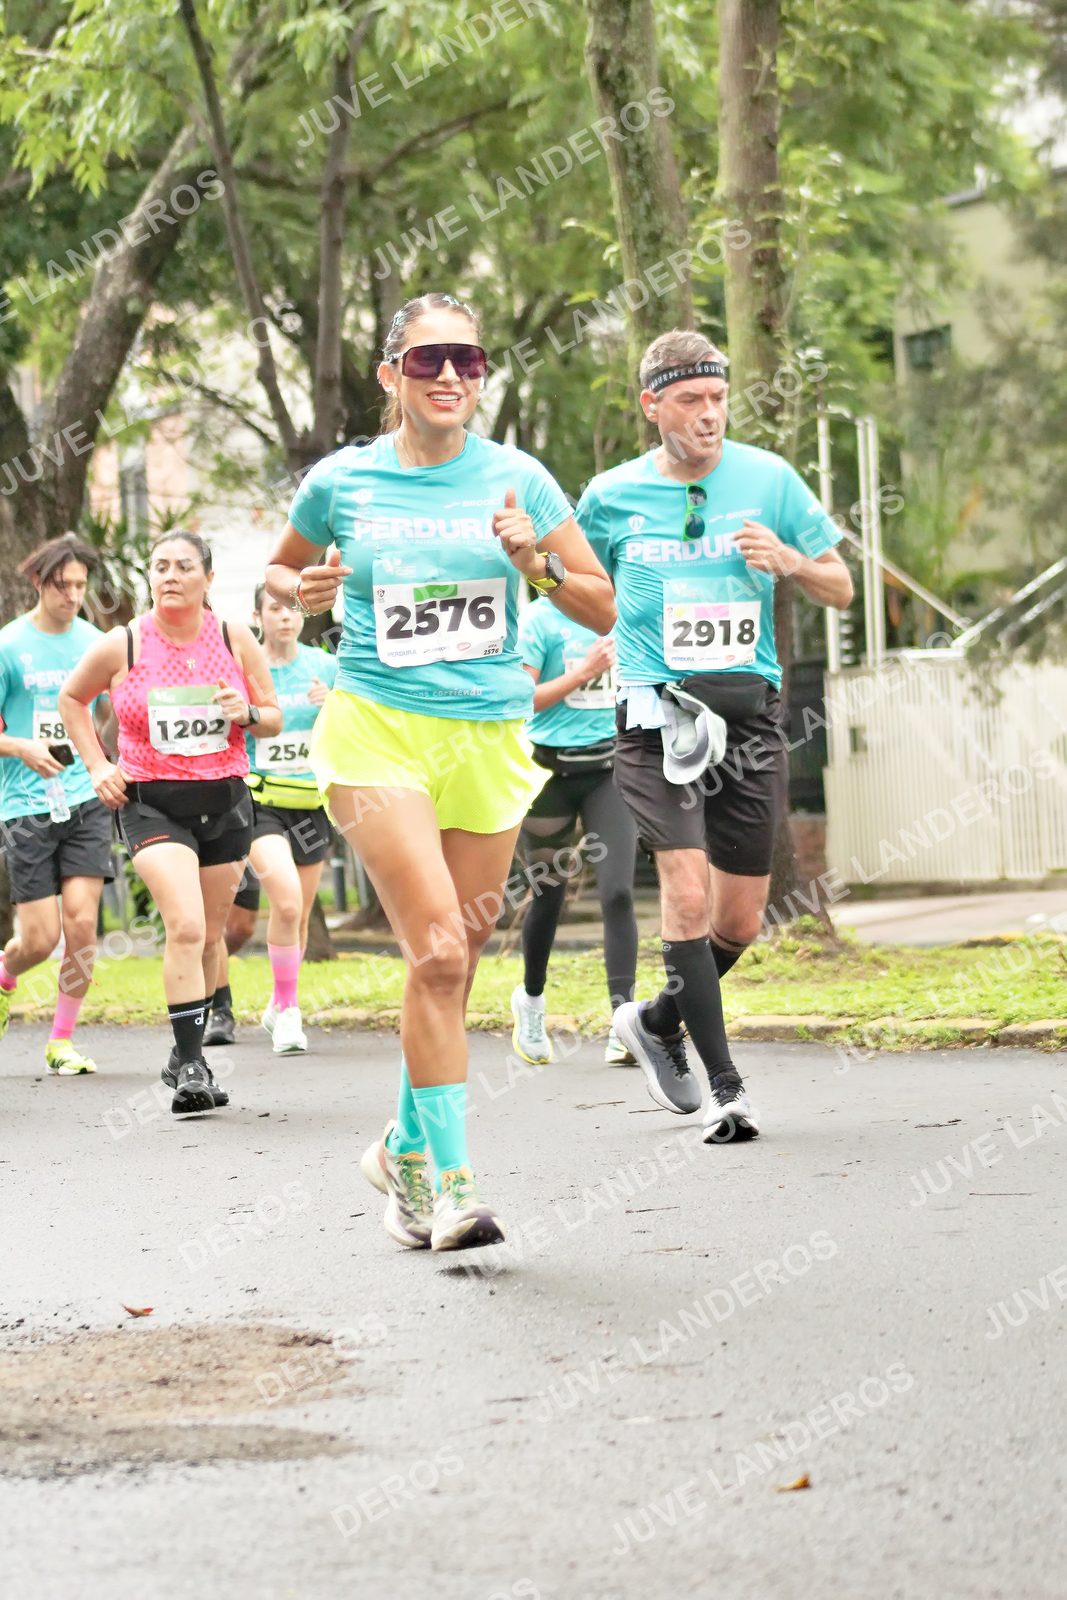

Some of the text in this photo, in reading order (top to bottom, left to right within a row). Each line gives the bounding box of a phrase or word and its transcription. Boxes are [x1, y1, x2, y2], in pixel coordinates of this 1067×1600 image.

[384, 595, 496, 640] 2576
[672, 618, 755, 647] 2918
[483, 647, 499, 655] 2576
[40, 722, 69, 740] 58
[157, 718, 225, 742] 1202
